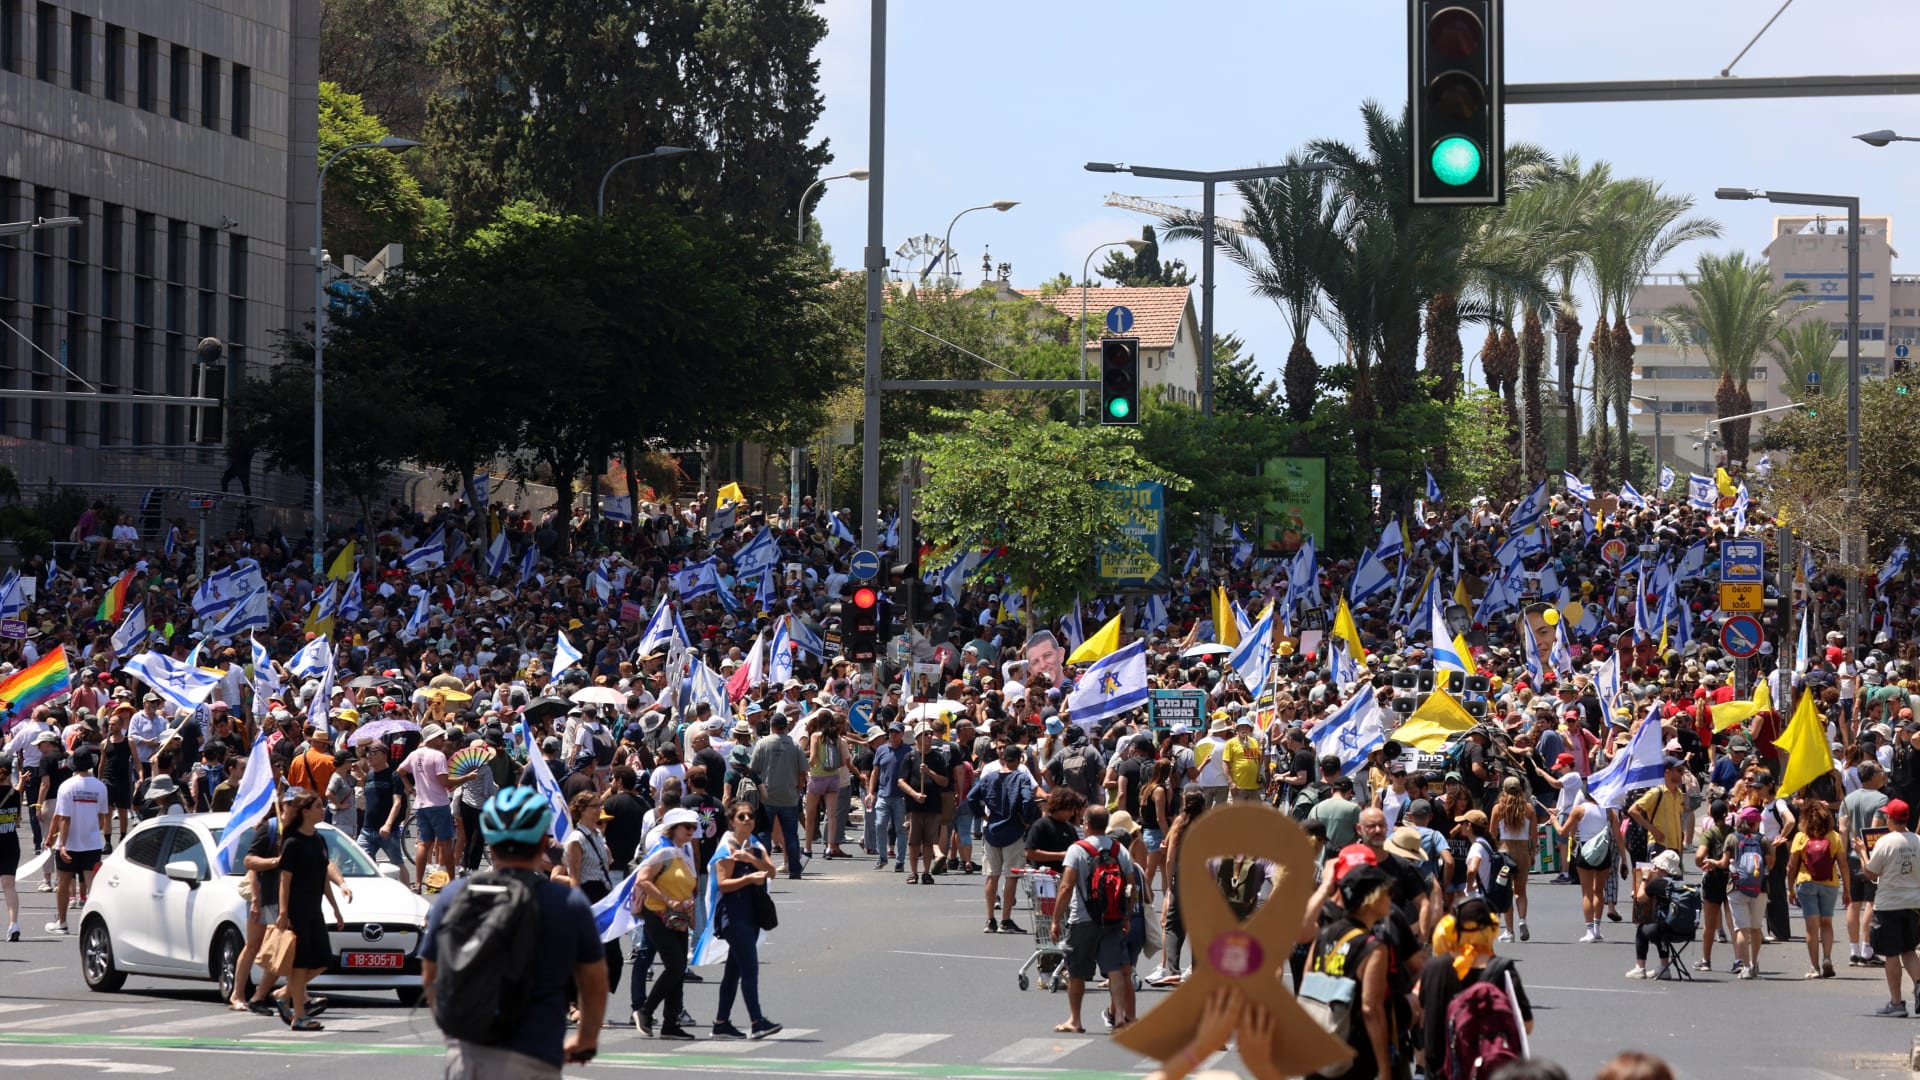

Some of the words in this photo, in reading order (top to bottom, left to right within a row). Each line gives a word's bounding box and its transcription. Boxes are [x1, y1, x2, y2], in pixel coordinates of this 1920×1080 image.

[1154, 698, 1180, 707] כולם.
[1182, 699, 1197, 707] את
[1157, 709, 1194, 717] בהסכם.
